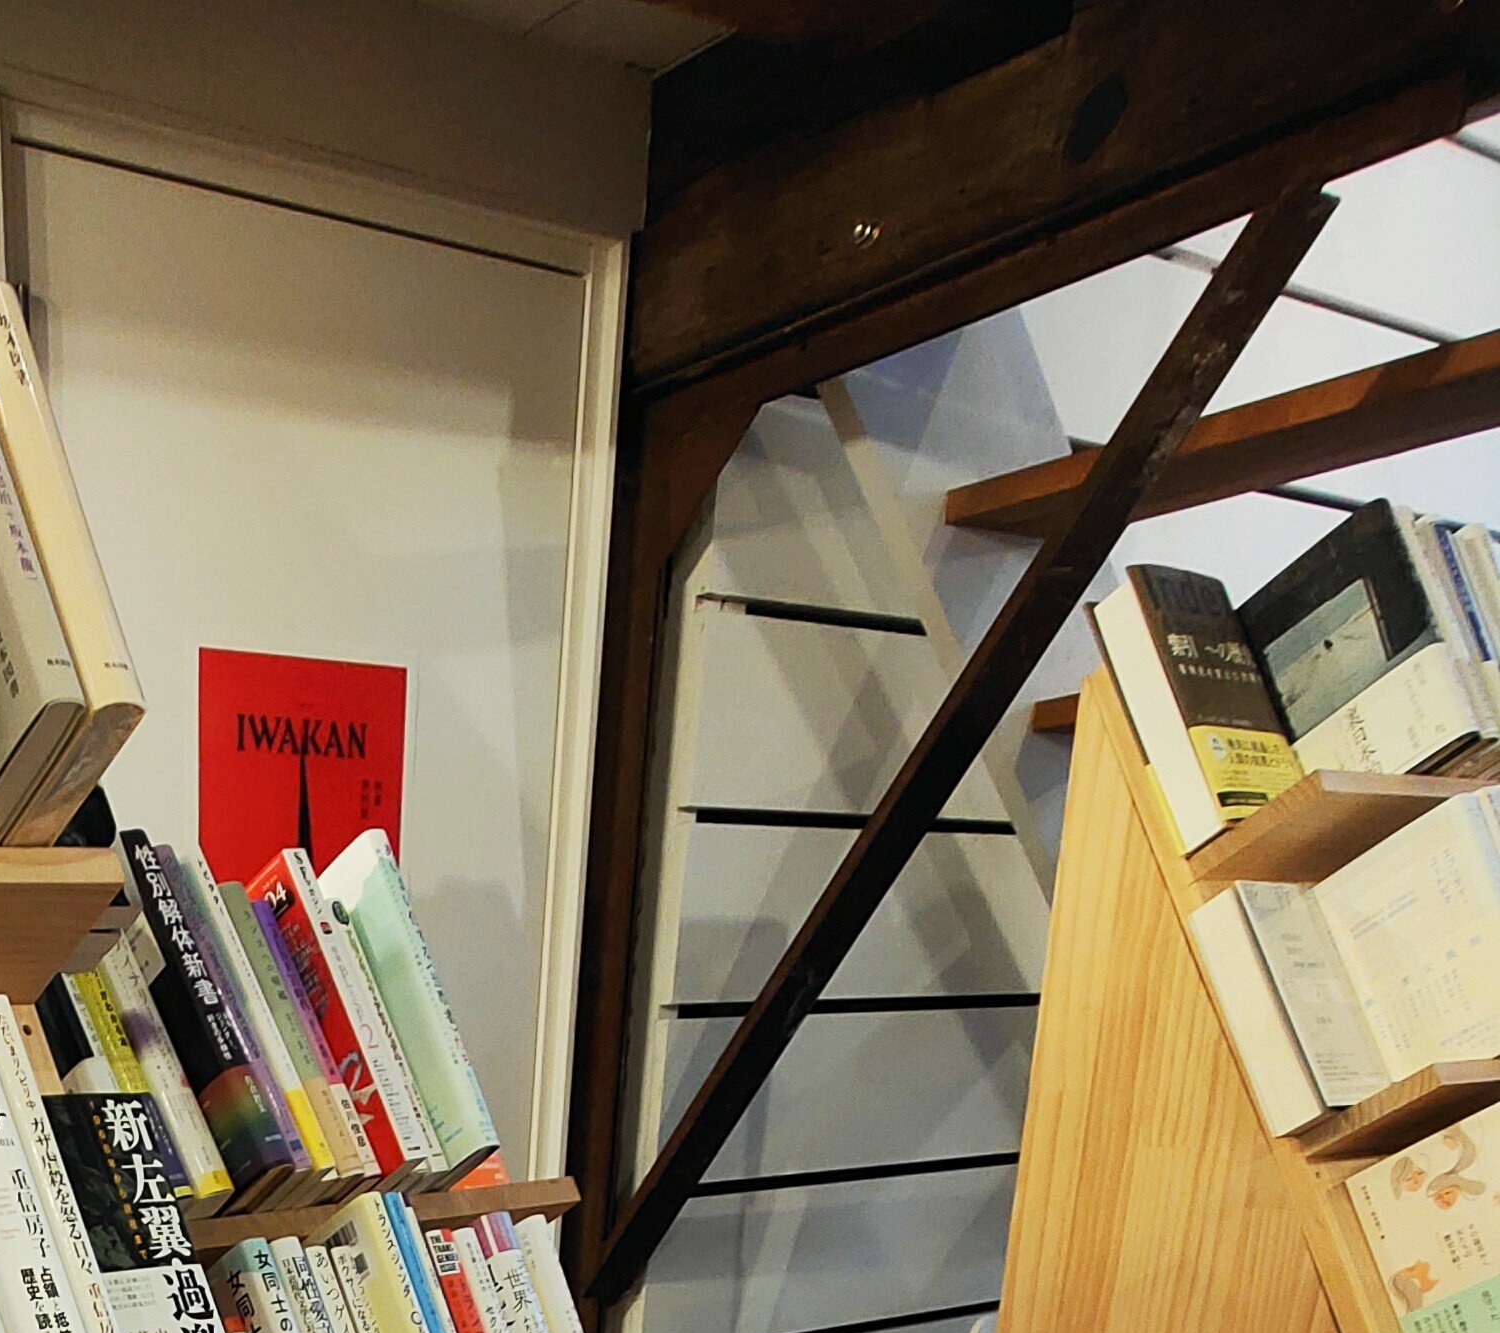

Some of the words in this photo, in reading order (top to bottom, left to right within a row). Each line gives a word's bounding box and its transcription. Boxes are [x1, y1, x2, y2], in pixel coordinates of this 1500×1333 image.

[237, 713, 368, 759] IWAKAN
[135, 844, 218, 1005] 性別解体新書
[11, 1168, 50, 1258] 重信房子
